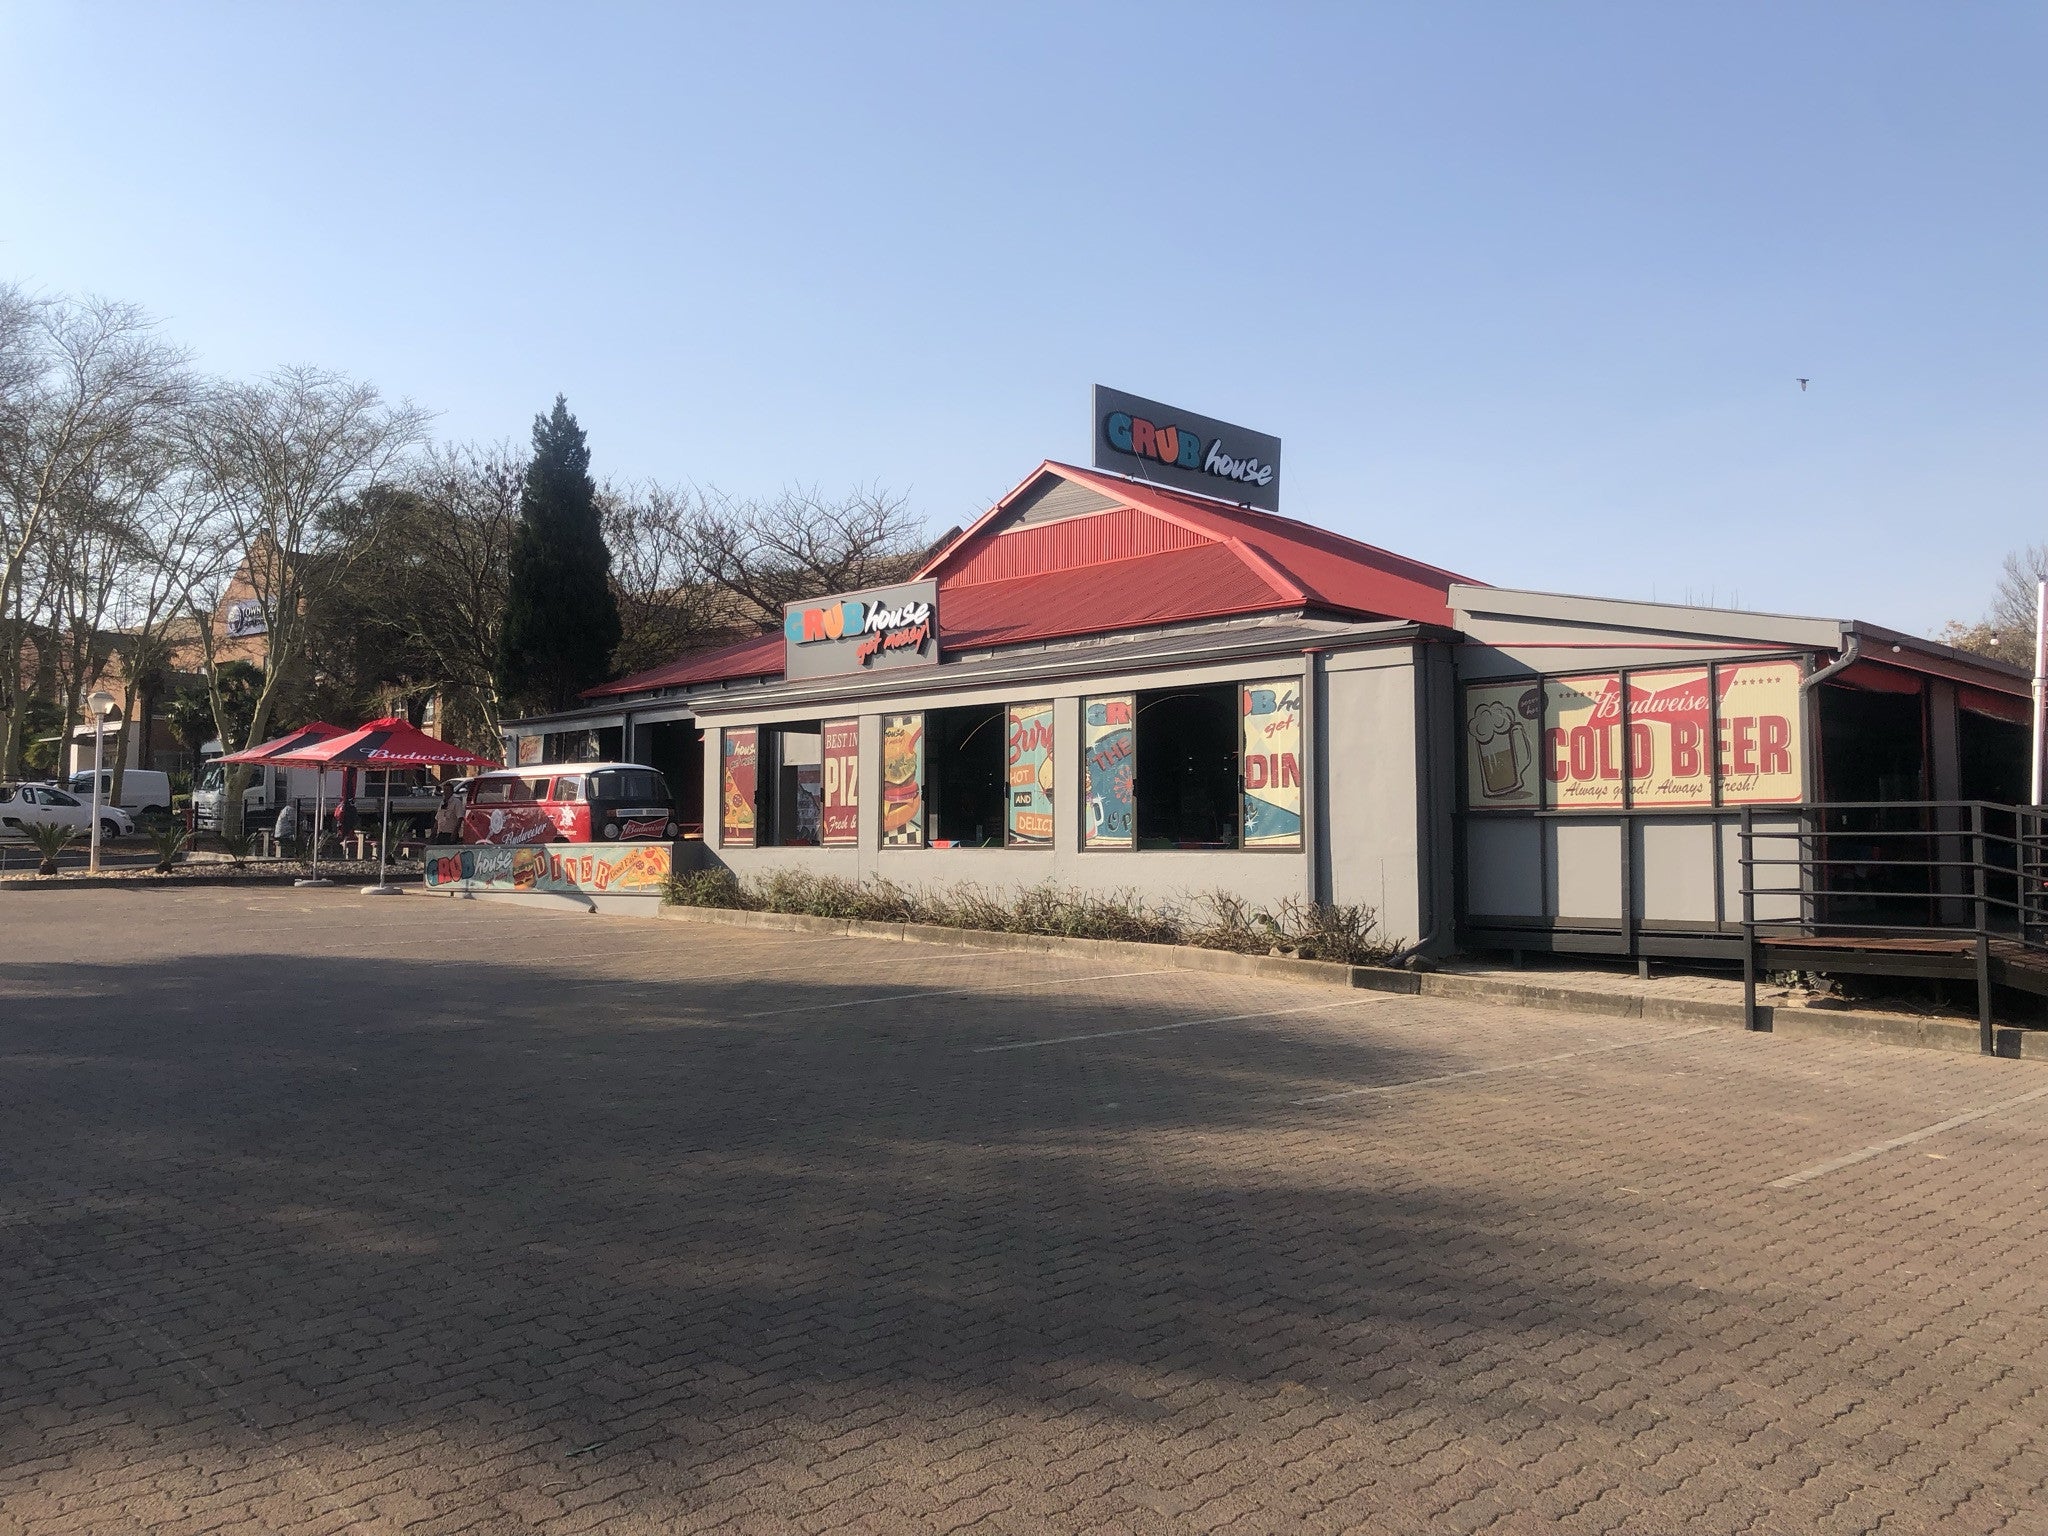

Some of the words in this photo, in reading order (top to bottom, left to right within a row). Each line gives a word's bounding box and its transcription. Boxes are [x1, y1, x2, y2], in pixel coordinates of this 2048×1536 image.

[1106, 411, 1200, 469] GRUB
[1204, 439, 1273, 486] house
[785, 602, 865, 641] GRUB
[864, 600, 930, 633] house
[856, 630, 882, 665] get
[1088, 702, 1132, 726] GR
[1264, 714, 1294, 738] get
[826, 734, 848, 749] BEST
[849, 732, 858, 747] IN
[1545, 723, 1653, 782] COLD
[1671, 715, 1792, 777] BEER
[360, 749, 474, 762] Budweiser
[1093, 736, 1132, 772] THE
[825, 755, 858, 808] PIZ
[1010, 770, 1029, 783] HOT
[1245, 753, 1300, 789] DIN
[1015, 795, 1031, 804] AND
[1563, 780, 1608, 799] Always
[1613, 779, 1653, 800] god!
[1655, 778, 1704, 798] Always
[626, 823, 664, 835] Budweiser
[850, 814, 857, 829] &
[1018, 815, 1052, 831] DELICI
[427, 850, 475, 886] GRUB
[475, 850, 513, 876] house
[534, 852, 612, 889] DINER
